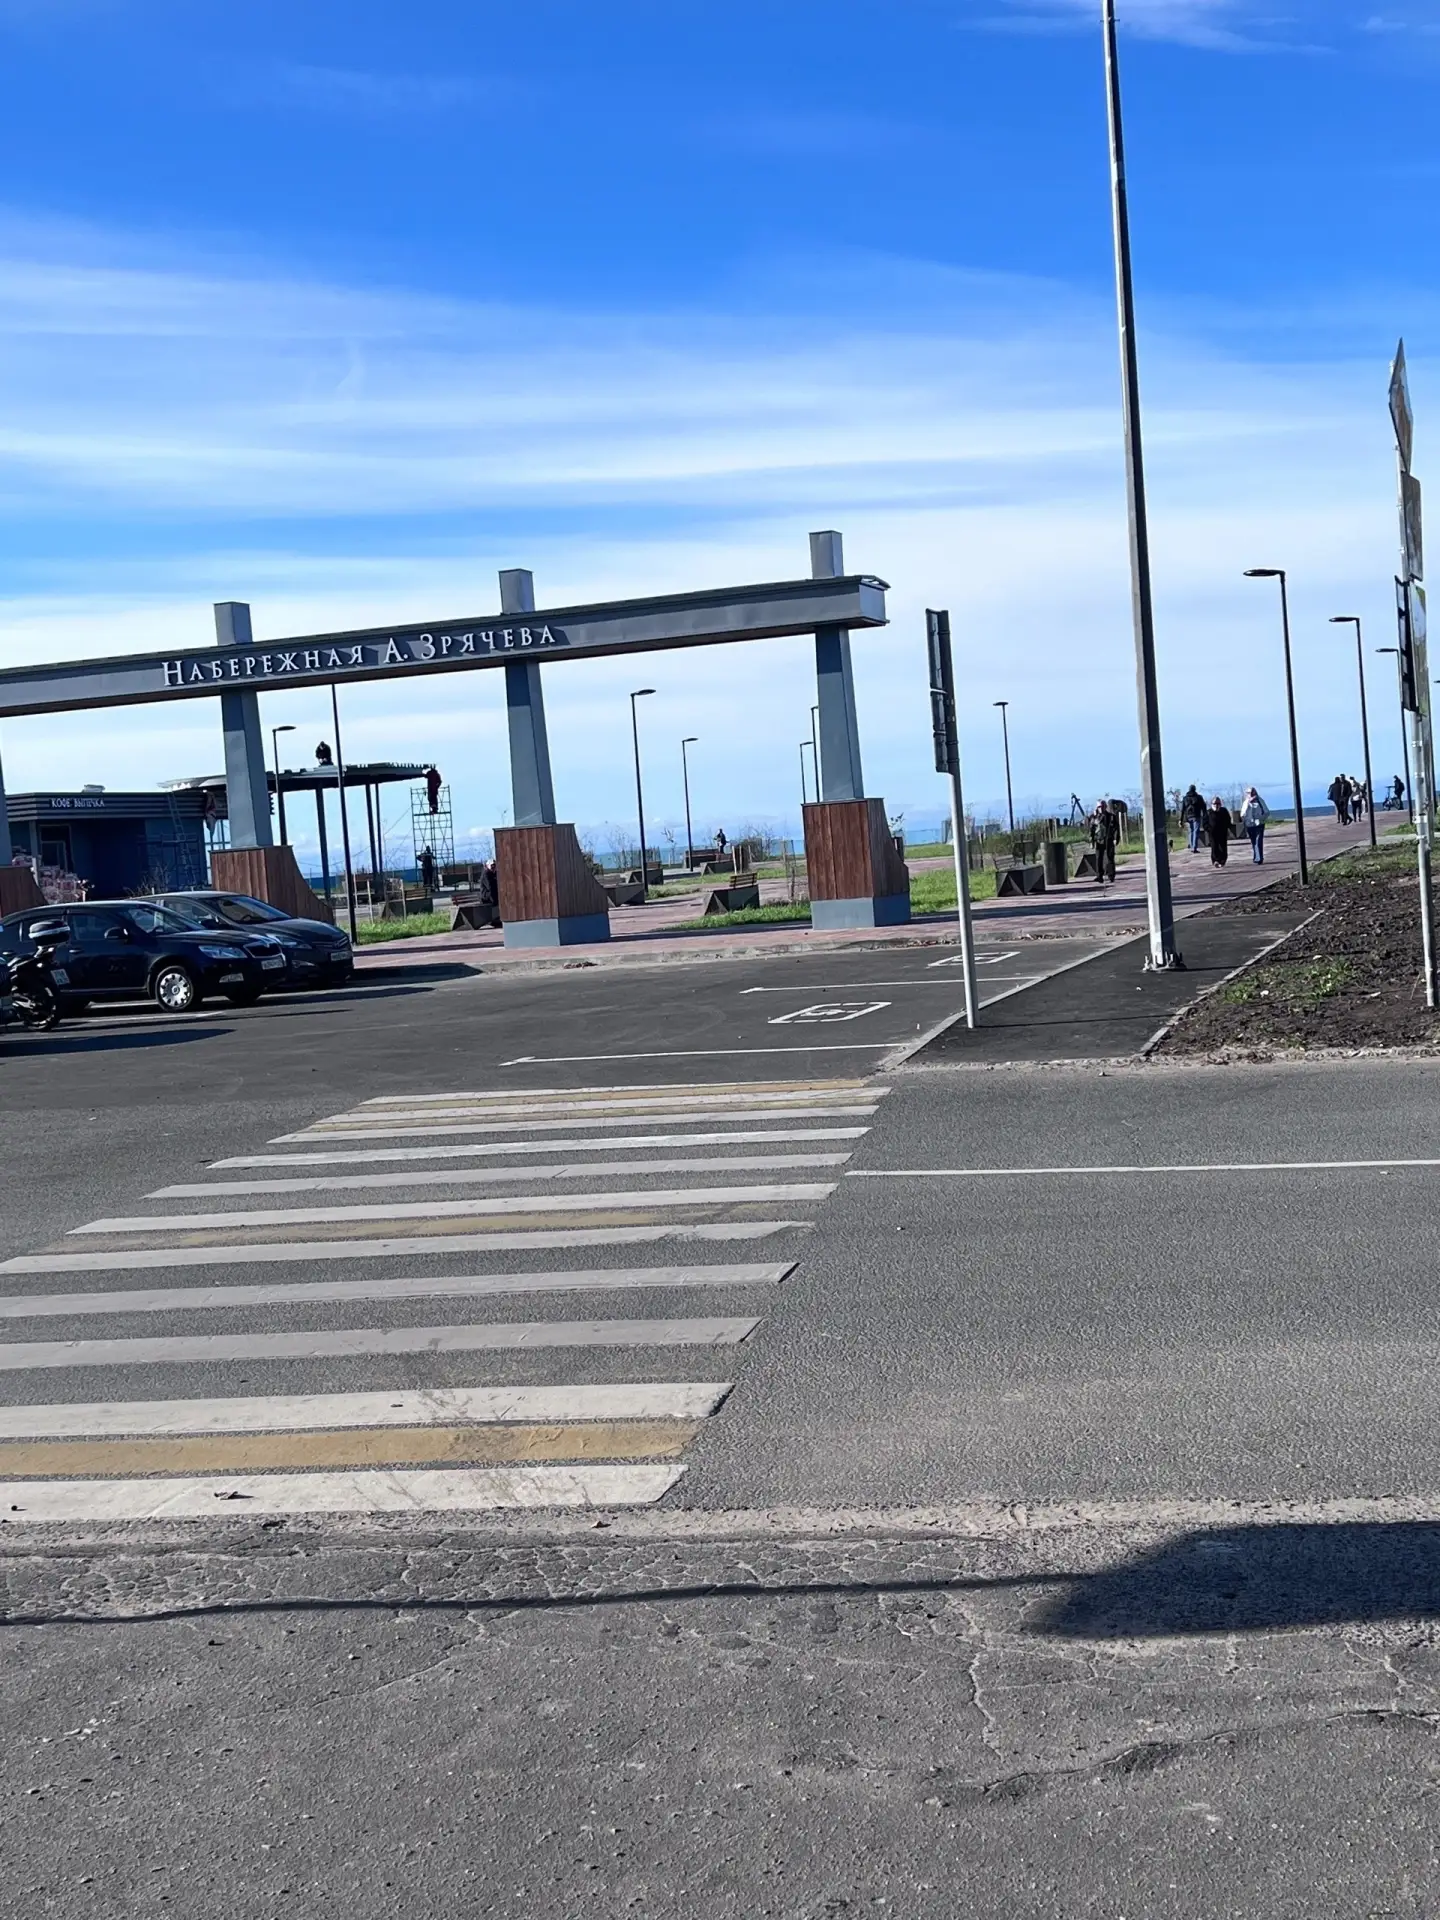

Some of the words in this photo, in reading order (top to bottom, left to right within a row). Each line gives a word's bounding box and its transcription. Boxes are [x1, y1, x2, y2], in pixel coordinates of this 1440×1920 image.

[161, 645, 364, 686] НАБЕРЕЖНАЯ
[383, 637, 408, 663] А.
[420, 624, 556, 660] ЗРЯЧЕВА
